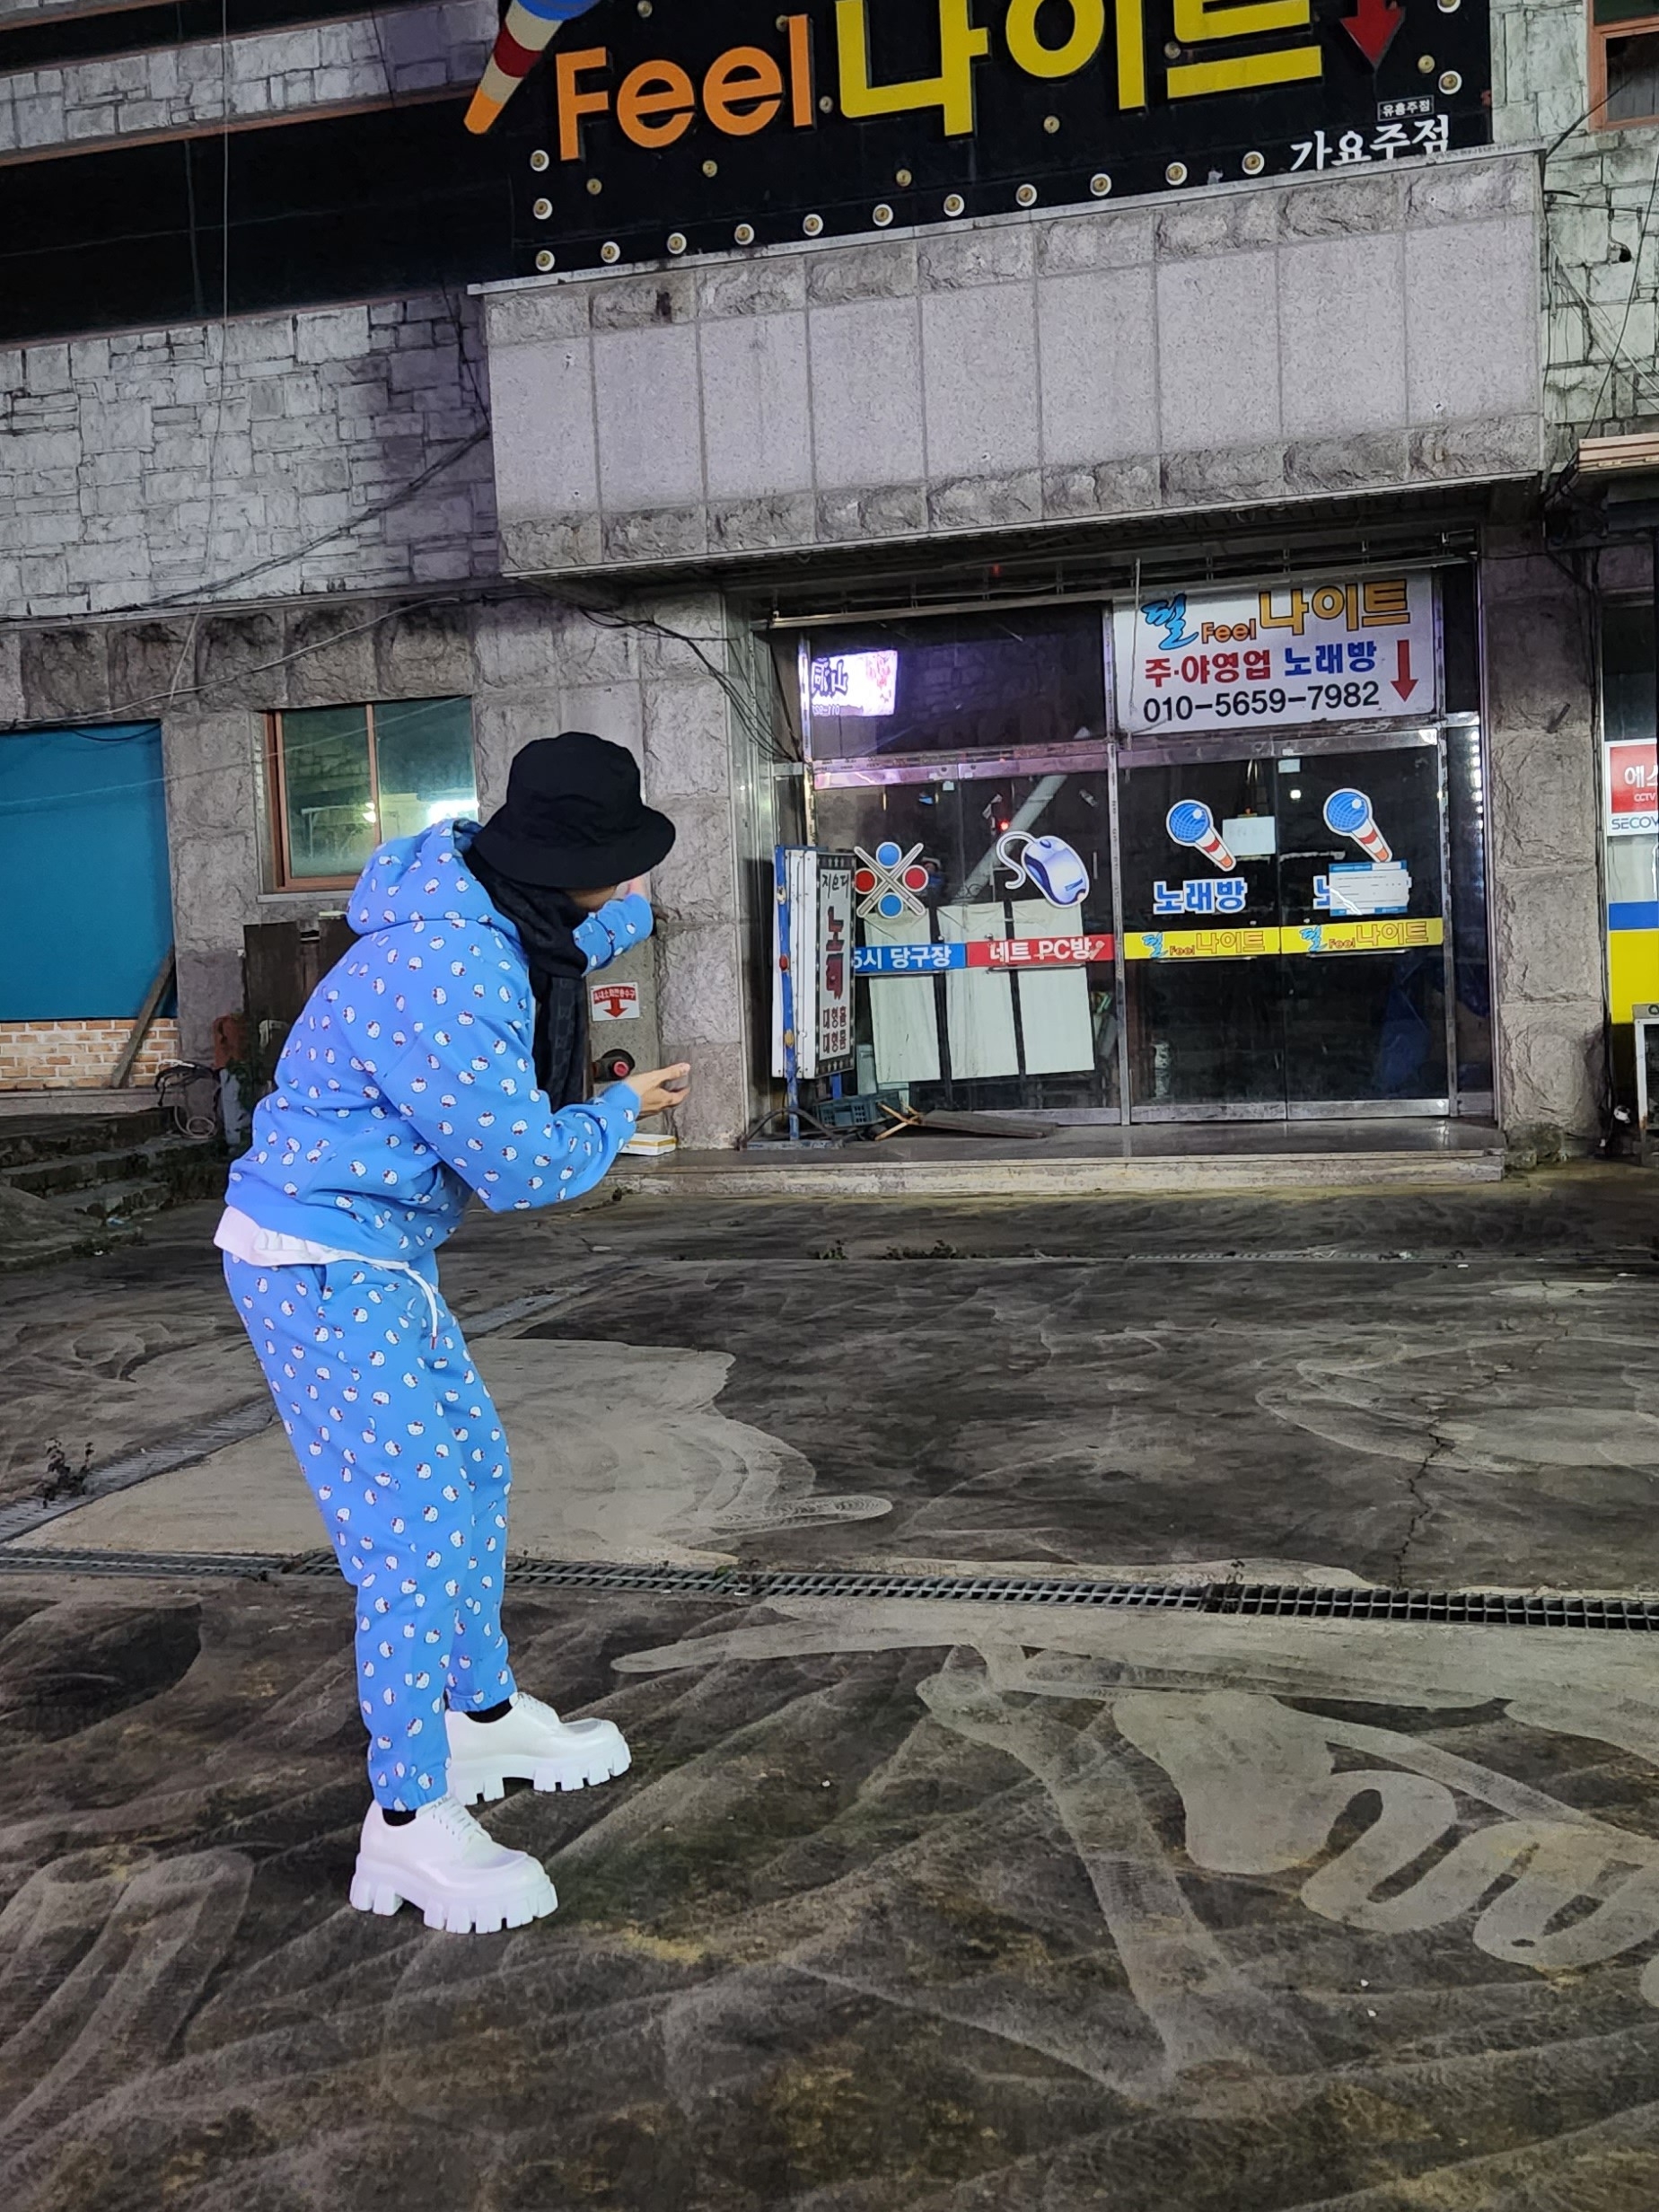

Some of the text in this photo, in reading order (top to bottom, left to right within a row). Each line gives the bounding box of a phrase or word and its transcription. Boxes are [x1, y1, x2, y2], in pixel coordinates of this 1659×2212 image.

[556, 0, 1322, 161] Feel 나이트
[1382, 99, 1431, 118] 유흥주점
[1290, 114, 1449, 171] 가요주점
[1201, 619, 1257, 645] Feel
[1259, 578, 1410, 636] 나이트
[1284, 640, 1377, 677] 노래방
[1143, 680, 1380, 723] 010-5659-7982
[1153, 877, 1248, 915] 노래방
[1038, 936, 1093, 961] PC방
[1170, 945, 1196, 956] Feel
[1196, 930, 1266, 954] 나이트
[1329, 937, 1356, 950] Feel
[1356, 921, 1429, 946] 나이트
[890, 945, 952, 969] 당구장
